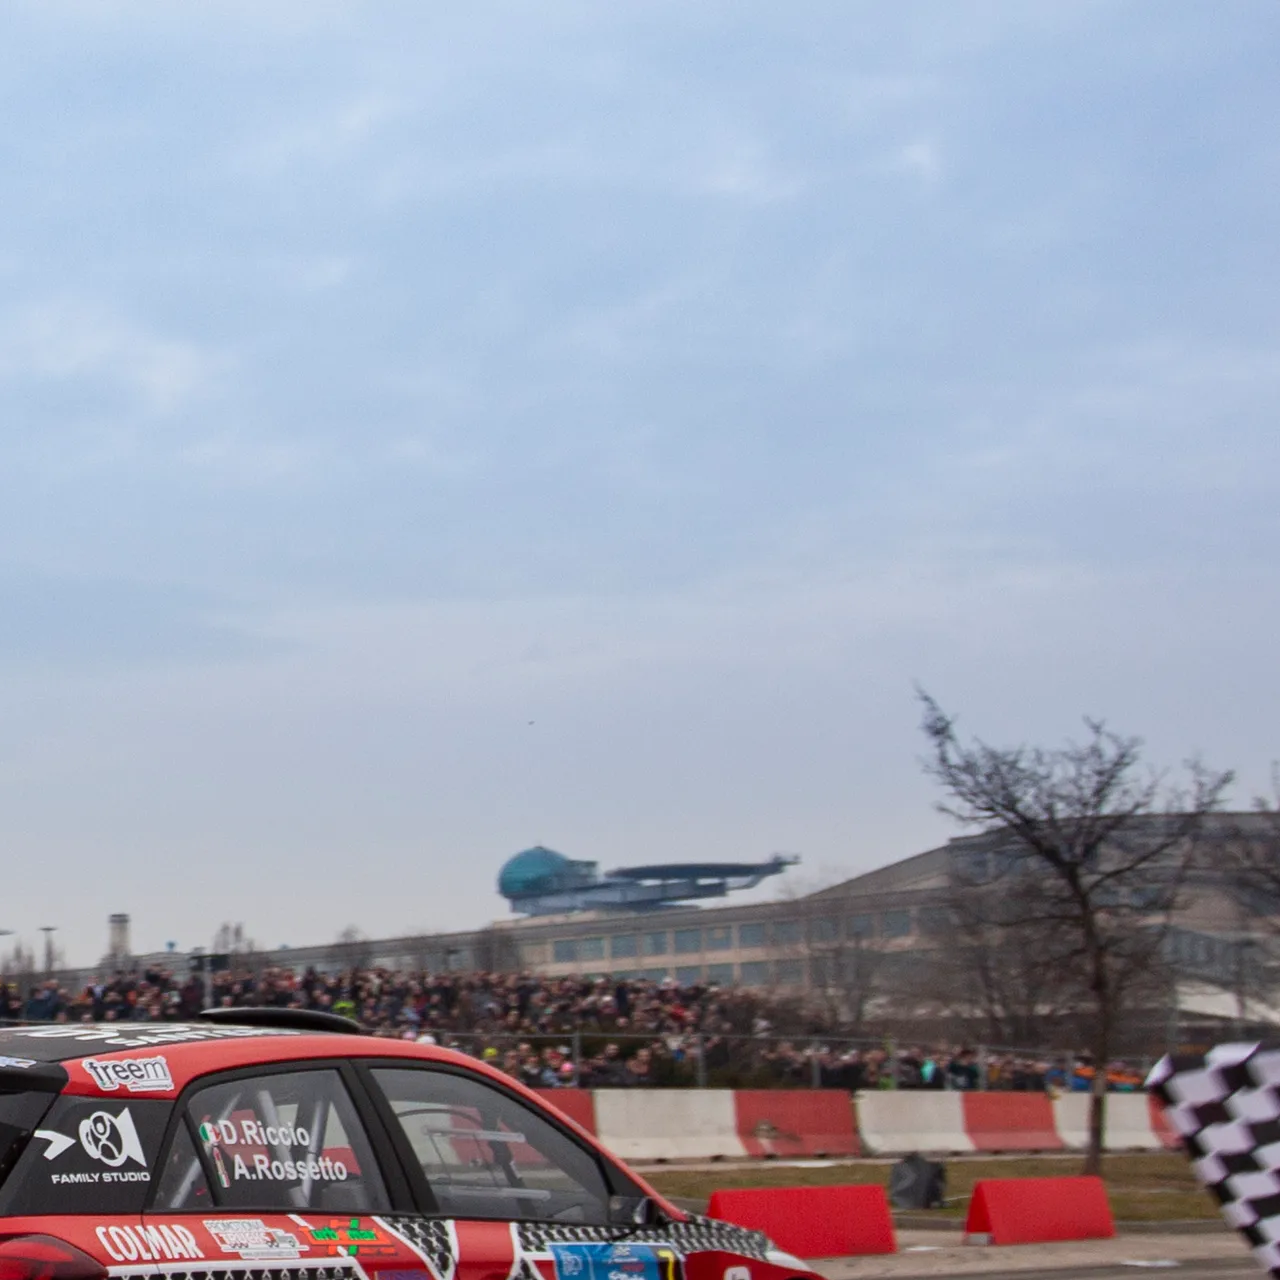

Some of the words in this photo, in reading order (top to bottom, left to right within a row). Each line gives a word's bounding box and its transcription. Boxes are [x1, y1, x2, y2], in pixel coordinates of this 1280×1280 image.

[88, 1061, 168, 1086] freem
[218, 1120, 310, 1146] D.Riccio
[51, 1173, 100, 1185] FAMILY
[102, 1171, 151, 1183] STUDIO
[233, 1154, 348, 1181] A.Rossetto
[95, 1224, 205, 1261] COLMAR
